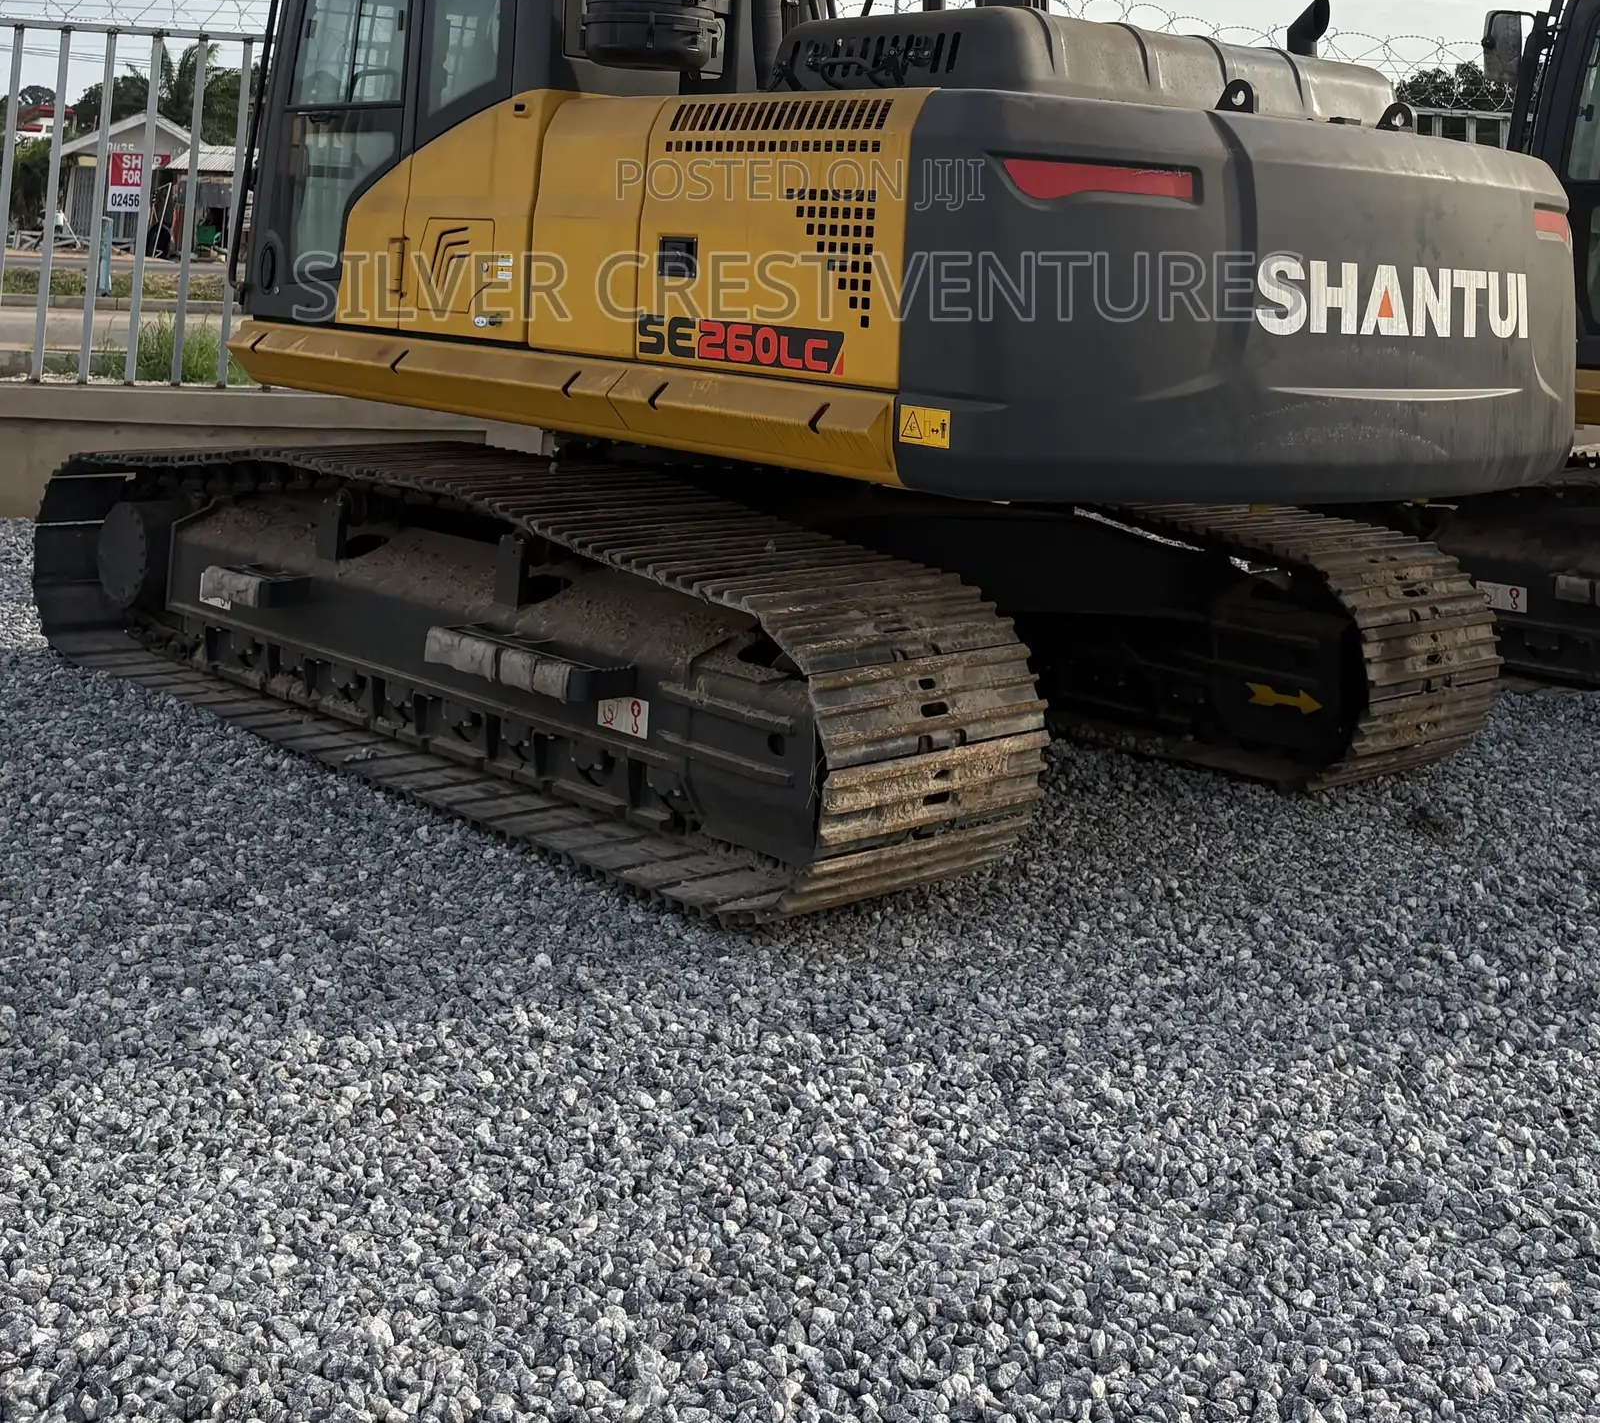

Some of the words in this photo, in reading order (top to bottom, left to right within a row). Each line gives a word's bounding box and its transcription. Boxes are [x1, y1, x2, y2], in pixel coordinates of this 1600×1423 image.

[122, 154, 162, 169] SHP
[122, 170, 141, 184] FOR
[111, 193, 140, 207] 02456
[1255, 255, 1528, 338] SHANTUI
[637, 314, 829, 371] SE260LC
